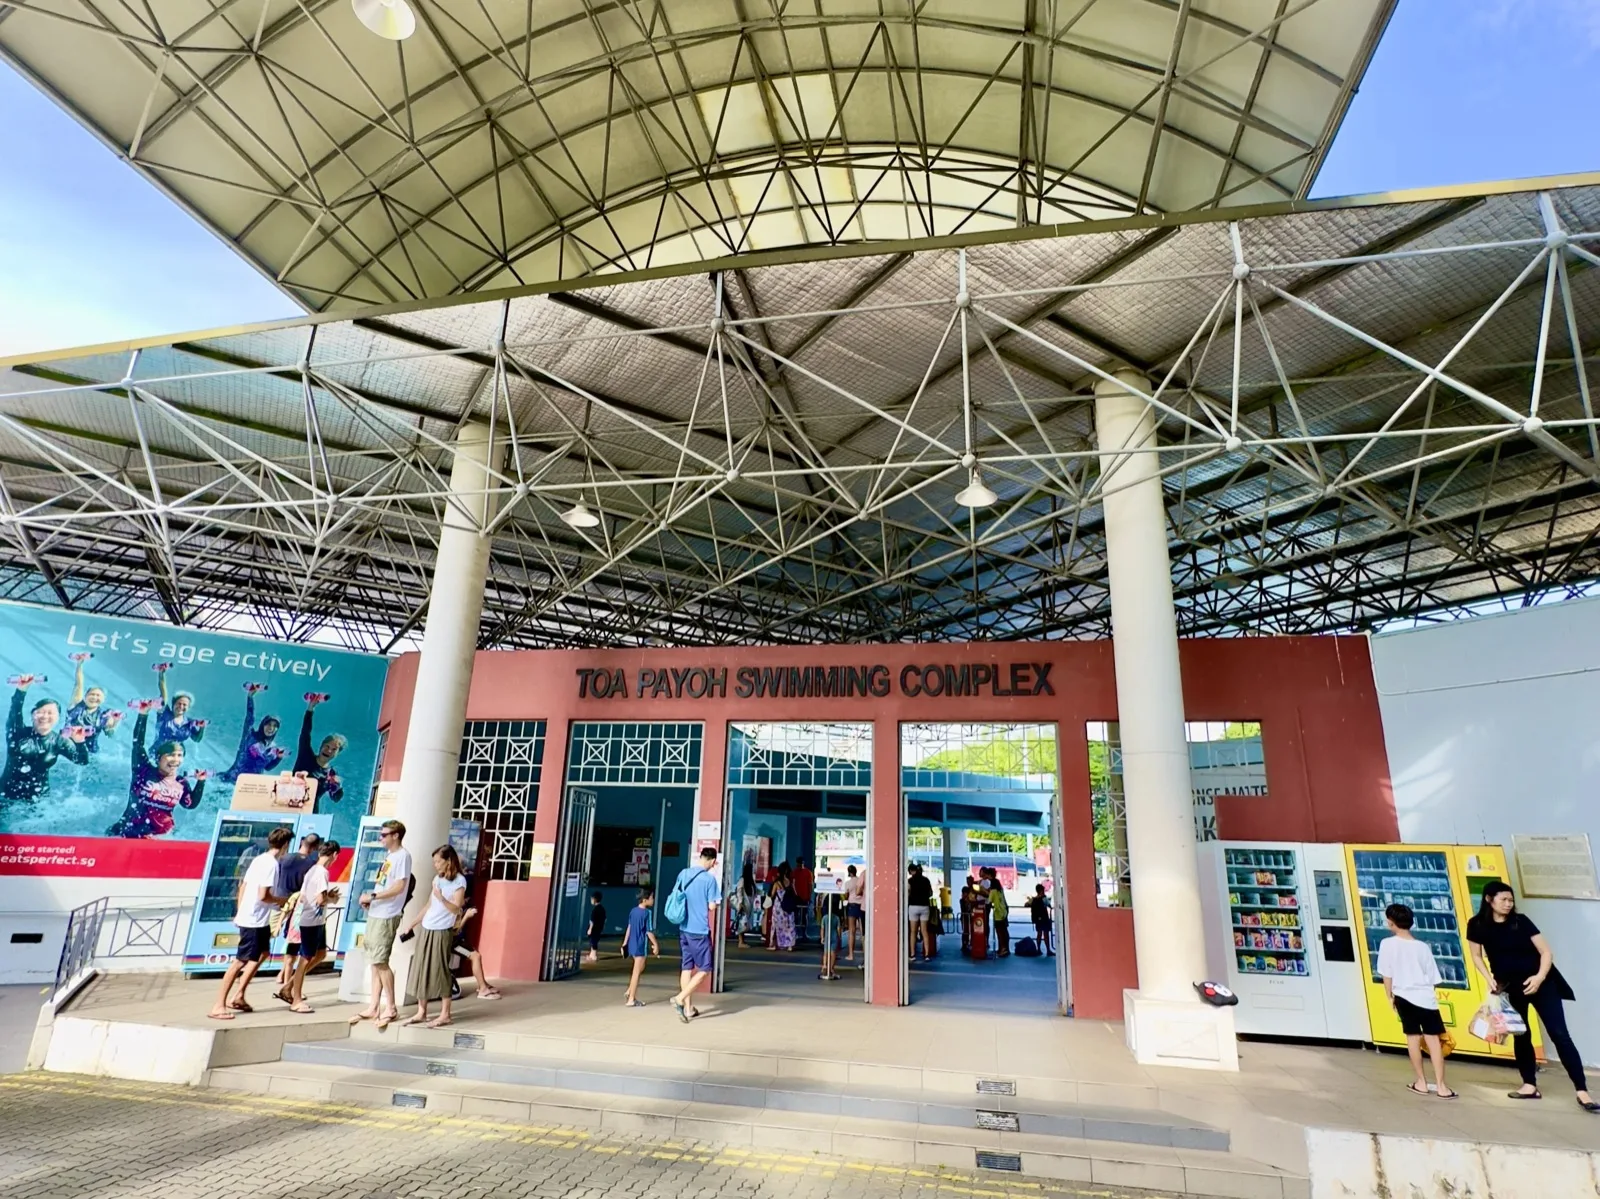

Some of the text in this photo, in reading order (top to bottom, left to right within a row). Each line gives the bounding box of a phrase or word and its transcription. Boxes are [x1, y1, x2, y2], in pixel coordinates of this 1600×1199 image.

[66, 625, 332, 682] Let's age actively
[576, 663, 1056, 699] TOA PAYOH SWIMMING COMPLEX
[17, 845, 35, 854] get
[37, 845, 76, 855] started!
